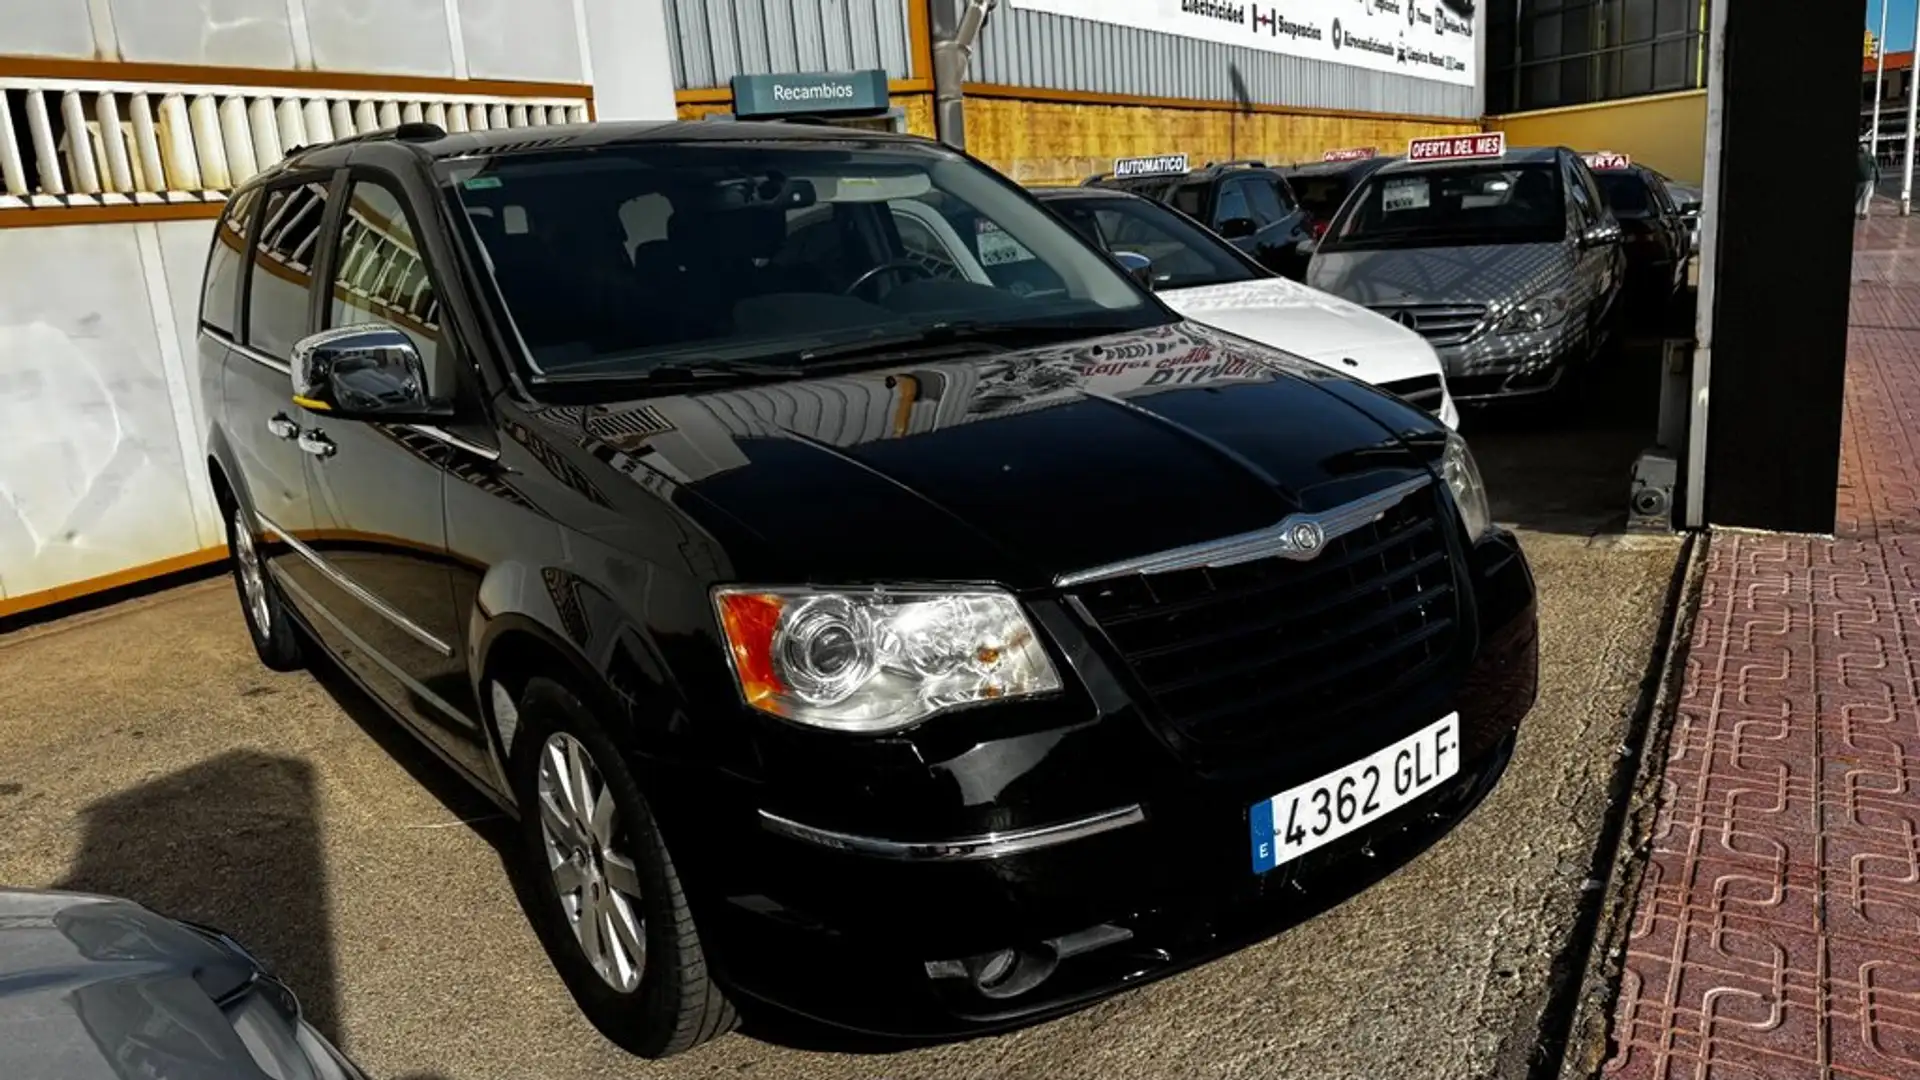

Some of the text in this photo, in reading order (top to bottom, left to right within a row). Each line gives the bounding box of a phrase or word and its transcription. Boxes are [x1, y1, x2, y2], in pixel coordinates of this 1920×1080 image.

[773, 82, 853, 101] Recambios
[1412, 137, 1499, 157] OFERTA DEL MES
[1117, 156, 1183, 174] AUTOMATICO
[1285, 725, 1450, 846] 4362 GLF
[1259, 843, 1269, 858] E
